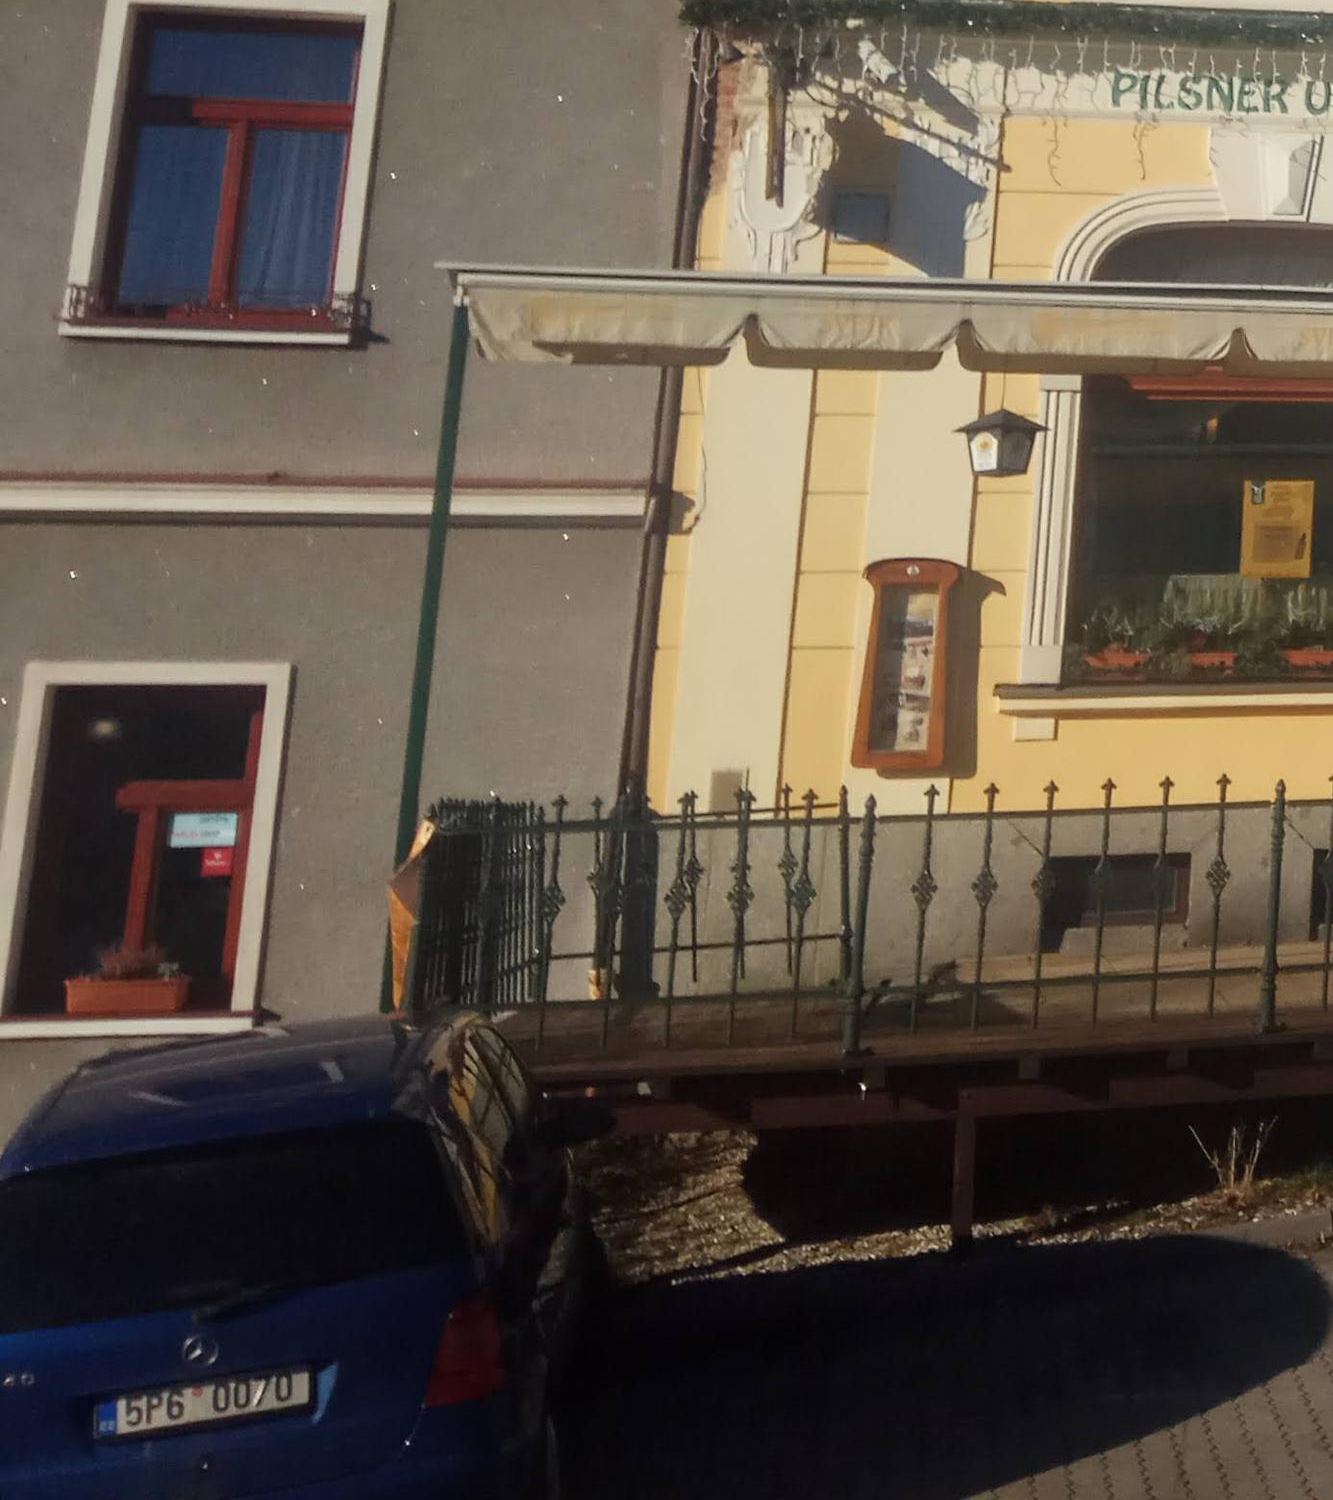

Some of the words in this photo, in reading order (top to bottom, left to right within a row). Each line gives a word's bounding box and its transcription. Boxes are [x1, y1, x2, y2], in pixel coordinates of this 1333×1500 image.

[1110, 72, 1290, 114] PILSNER
[123, 1388, 185, 1428] 5P6
[211, 1374, 294, 1414] 0070
